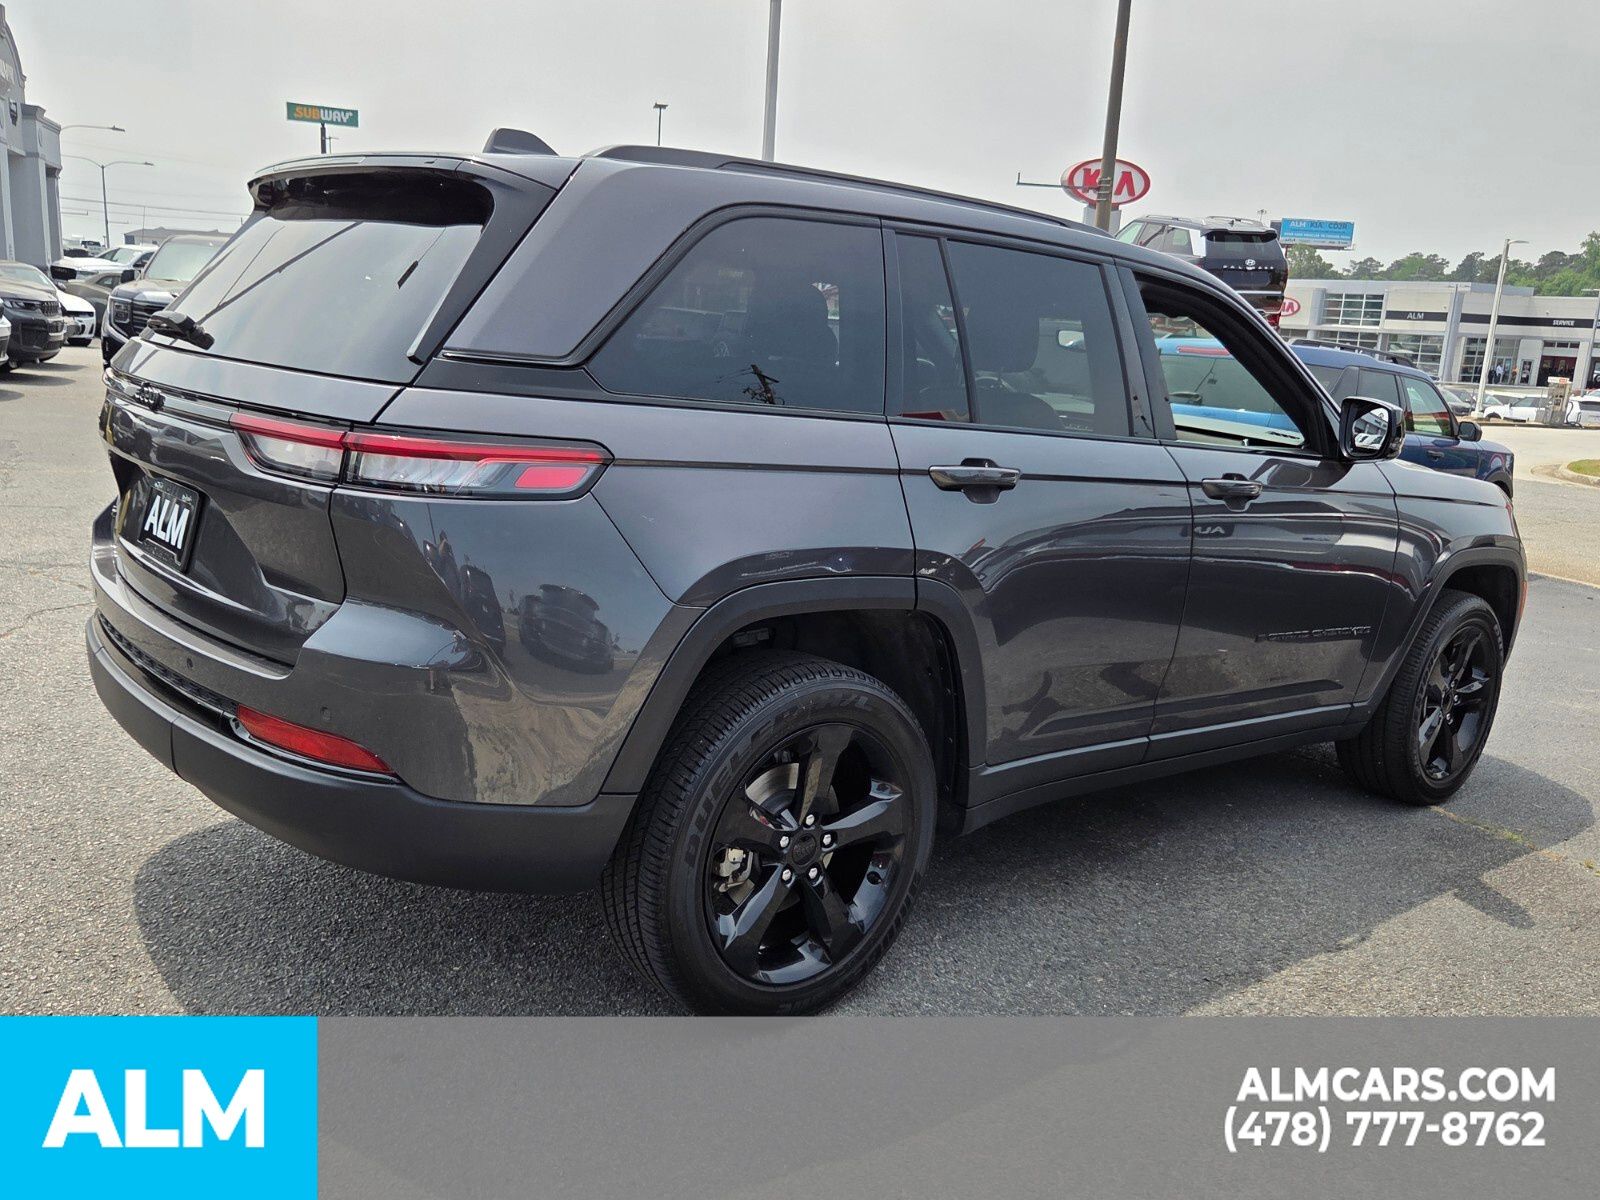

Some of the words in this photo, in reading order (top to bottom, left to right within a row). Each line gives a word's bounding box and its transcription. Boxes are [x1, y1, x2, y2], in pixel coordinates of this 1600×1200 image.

[294, 106, 350, 123] SUBWAY
[1083, 168, 1136, 197] KA
[1406, 312, 1424, 320] ALM
[144, 494, 190, 550] ALM
